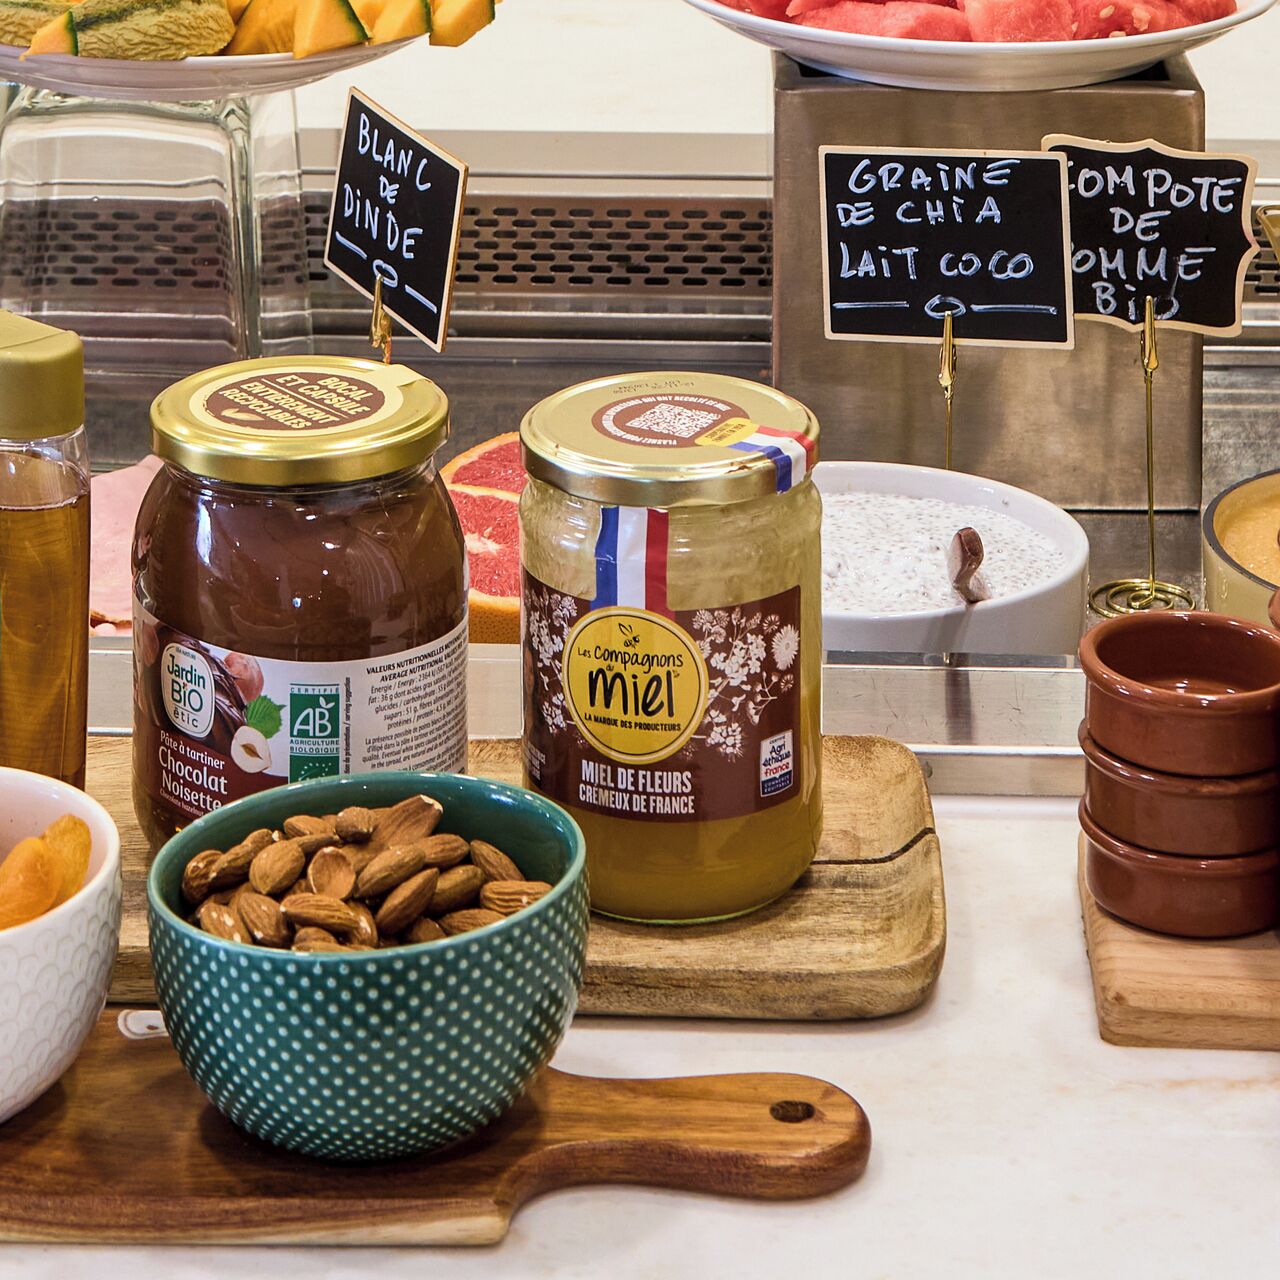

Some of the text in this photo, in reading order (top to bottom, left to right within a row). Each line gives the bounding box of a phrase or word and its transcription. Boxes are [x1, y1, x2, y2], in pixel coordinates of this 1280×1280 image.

[358, 112, 432, 192] BLANC
[379, 174, 400, 205] DE
[1068, 161, 1242, 214] OMPOTE
[835, 201, 875, 228] DE
[1109, 206, 1172, 242] DE
[1071, 241, 1217, 282] OMME
[275, 374, 371, 415] ET CAPSULE
[317, 376, 374, 402] BOCAL
[218, 388, 313, 430] RECYCLABLES
[167, 653, 206, 690] Jardin
[366, 663, 396, 675] VALEURS
[396, 645, 445, 670] NUTRITIONNELLES
[380, 671, 408, 683] AVERAGE
[408, 655, 444, 675] NUTRITIONAL
[577, 645, 684, 674] Les Compagnons
[605, 663, 615, 672] du
[293, 707, 332, 737] AB
[374, 702, 399, 715] glucides
[383, 710, 402, 721] sugars
[584, 712, 682, 732] LA MARQUE DES PRODUCTEURS
[387, 719, 412, 731] protéines
[160, 730, 225, 770] Pâte à tartiner
[290, 746, 340, 754] BIOLOGIQUE
[158, 745, 228, 795] Chocolat
[581, 759, 693, 794] MIEL DE FLEURS
[162, 769, 222, 812] Noisette
[578, 782, 696, 814] CRÉMEUX DE FRANCE
